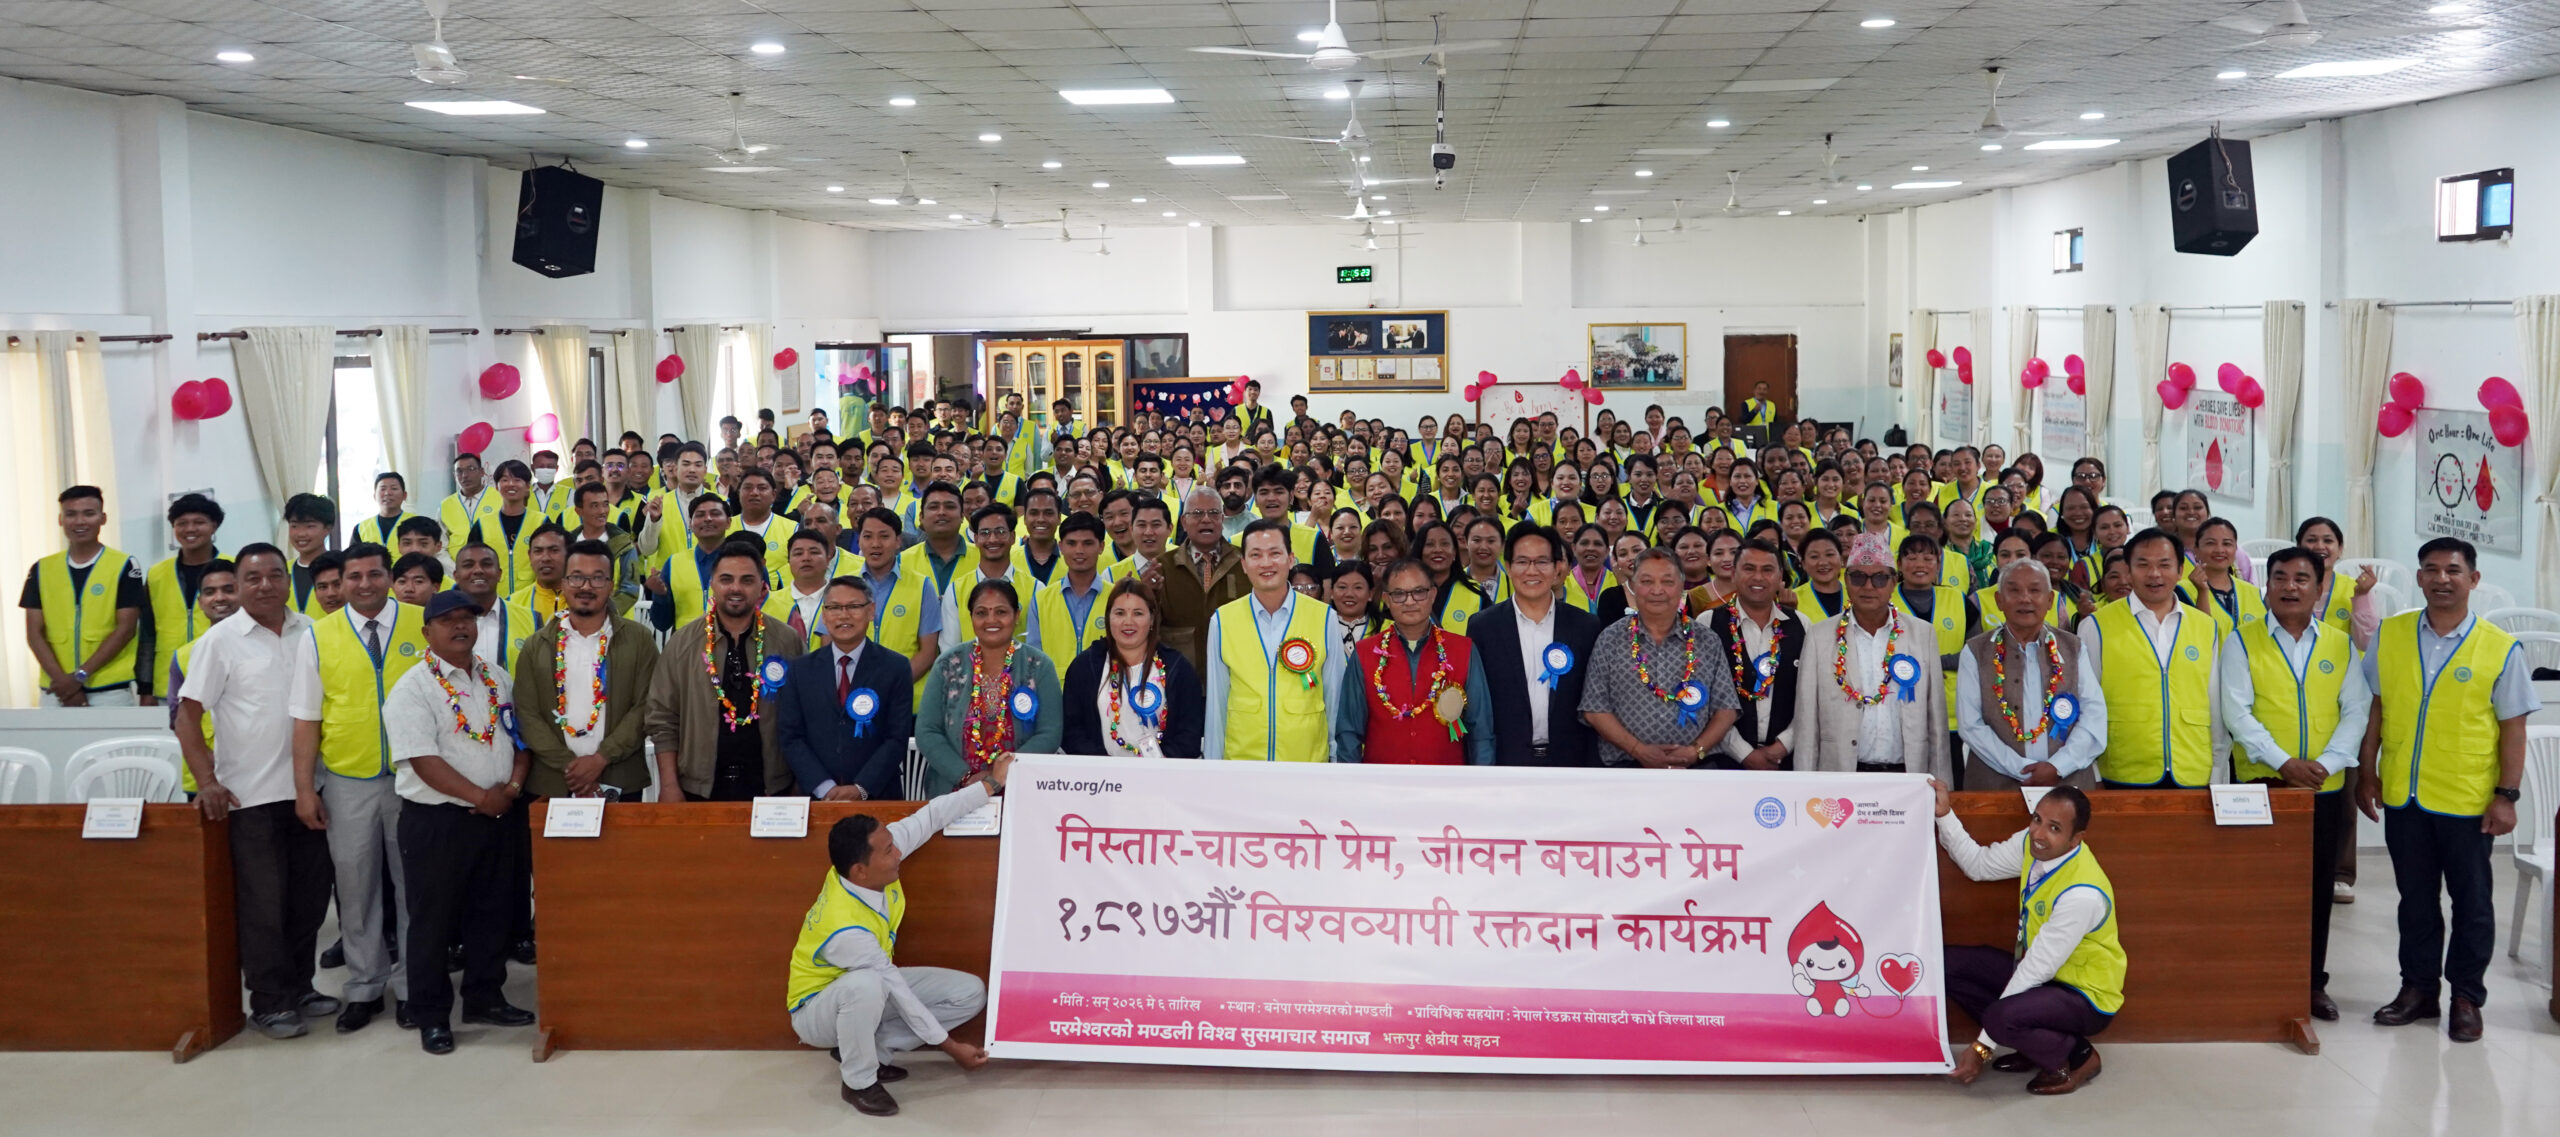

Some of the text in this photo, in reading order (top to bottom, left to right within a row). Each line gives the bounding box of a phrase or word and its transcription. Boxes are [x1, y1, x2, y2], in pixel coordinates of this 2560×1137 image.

[2199, 399, 2240, 417] HEROES SAVE LIVES
[2193, 413, 2204, 427] WITH
[2429, 428, 2443, 444] One
[2465, 424, 2480, 441] One
[2481, 431, 2495, 453] Life
[1036, 779, 1123, 795] watv.org/ne
[1056, 813, 1744, 881] निस्तार-चाडको प्रेम, जीवन बचाउने प्रेम
[1245, 890, 1460, 947] विश्वव्यापी
[1467, 909, 1604, 953] रक्तदान
[1612, 898, 1773, 955] कार्यक्रम
[1059, 992, 1084, 1007] मिति
[1092, 995, 1110, 1012] सन्
[1113, 997, 1143, 1009] २०२६
[1146, 994, 1155, 1009] मे
[1158, 998, 1166, 1010] ६
[1168, 995, 1202, 1012] तारिख
[1227, 1000, 1256, 1014] स्थान
[1263, 998, 1291, 1014] बनेपा
[1294, 1001, 1352, 1017] परमेश्वरको
[1354, 1002, 1393, 1017] मण्डली
[1414, 1004, 1463, 1020] प्राविधिक
[1466, 1006, 1504, 1021] सहयोग
[1512, 1006, 1542, 1022] नेपाल
[1544, 1007, 1581, 1023] रेडक्रस
[1584, 1008, 1629, 1024] सोसाइटी
[1632, 1010, 1656, 1025] काभ्रे
[1658, 1011, 1693, 1026] जिल्ला
[1696, 1014, 1725, 1027] शाखा
[1050, 1016, 1371, 1047] परमेश्वरको मण्डली विश्व सुसमाचार समाज
[1383, 1031, 1420, 1049] भक्तपुर
[1425, 1029, 1458, 1047] क्षेत्रीय
